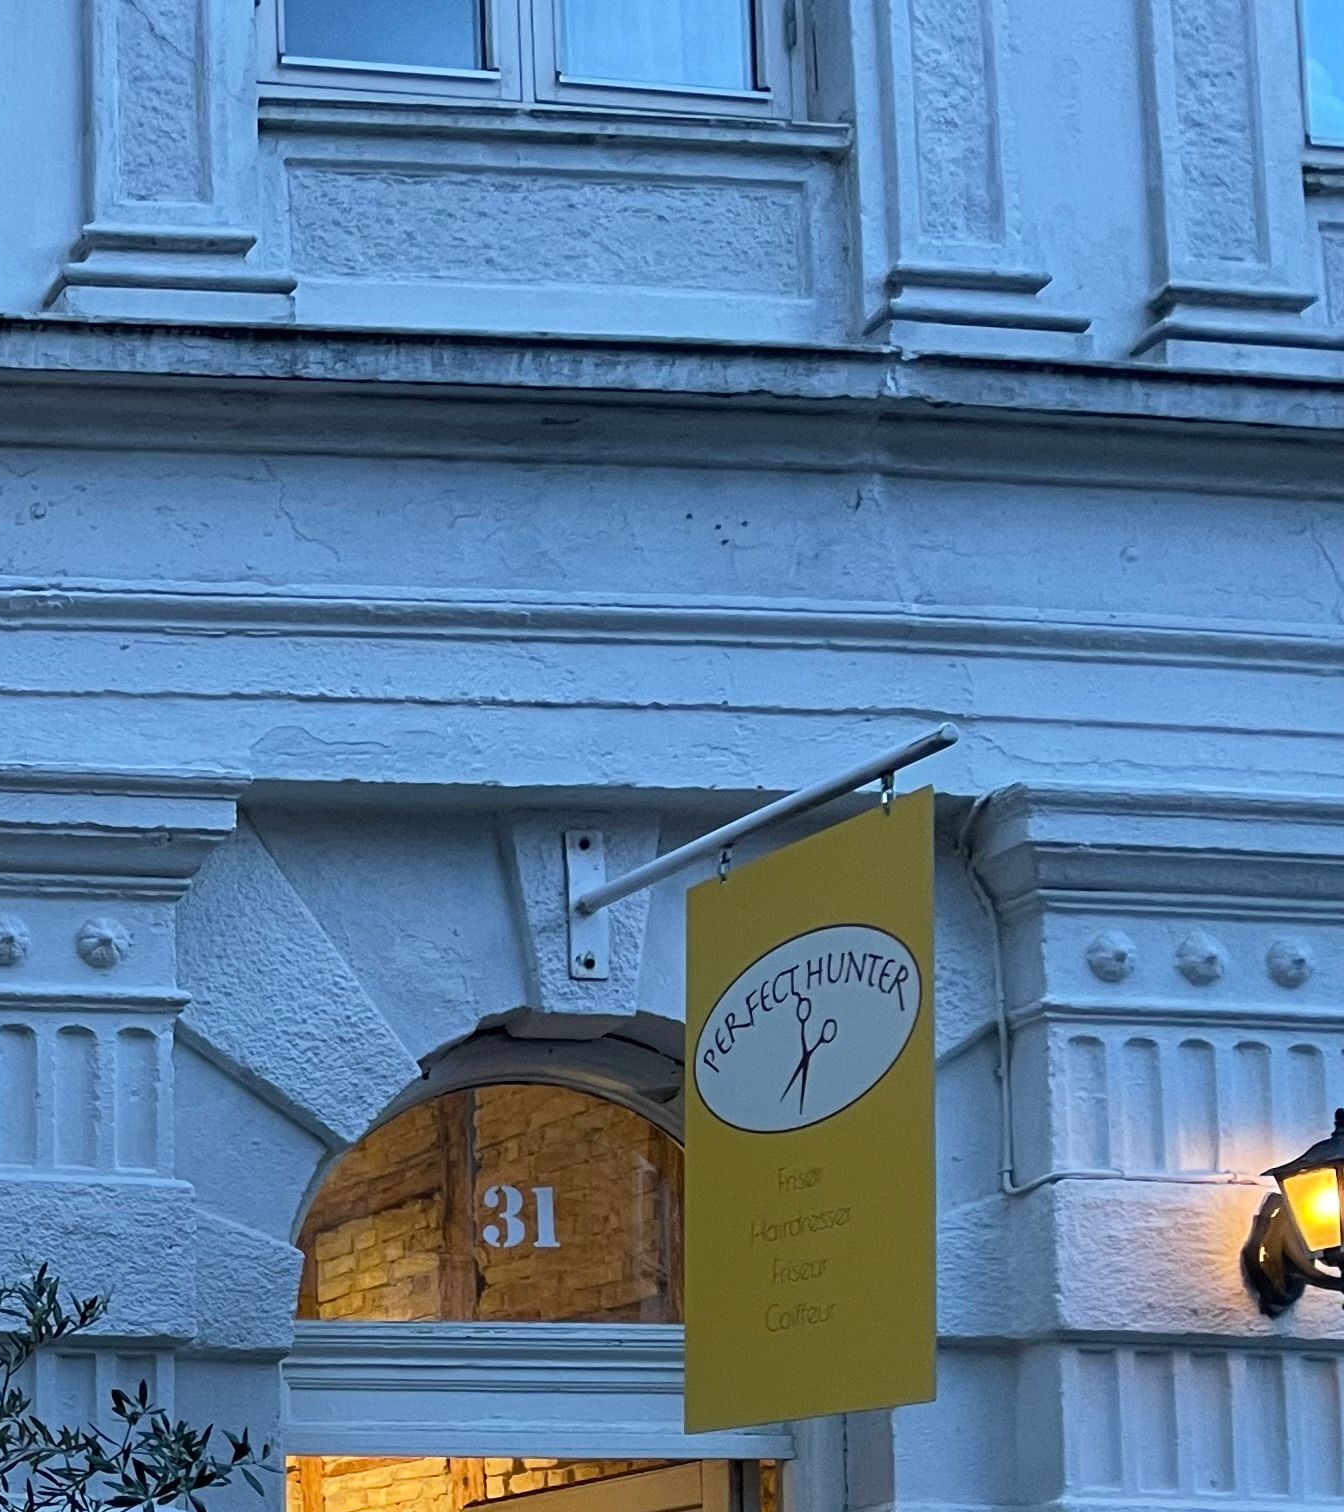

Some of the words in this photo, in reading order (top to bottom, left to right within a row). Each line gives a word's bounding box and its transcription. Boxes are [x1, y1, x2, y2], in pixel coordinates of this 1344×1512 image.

[703, 964, 800, 1073] PERFECT
[806, 950, 910, 1012] HUNTER
[482, 1184, 561, 1248] 31
[750, 1206, 853, 1248] Hairdresser
[772, 1257, 828, 1286] Friseur
[765, 1302, 837, 1333] Coiffeur
